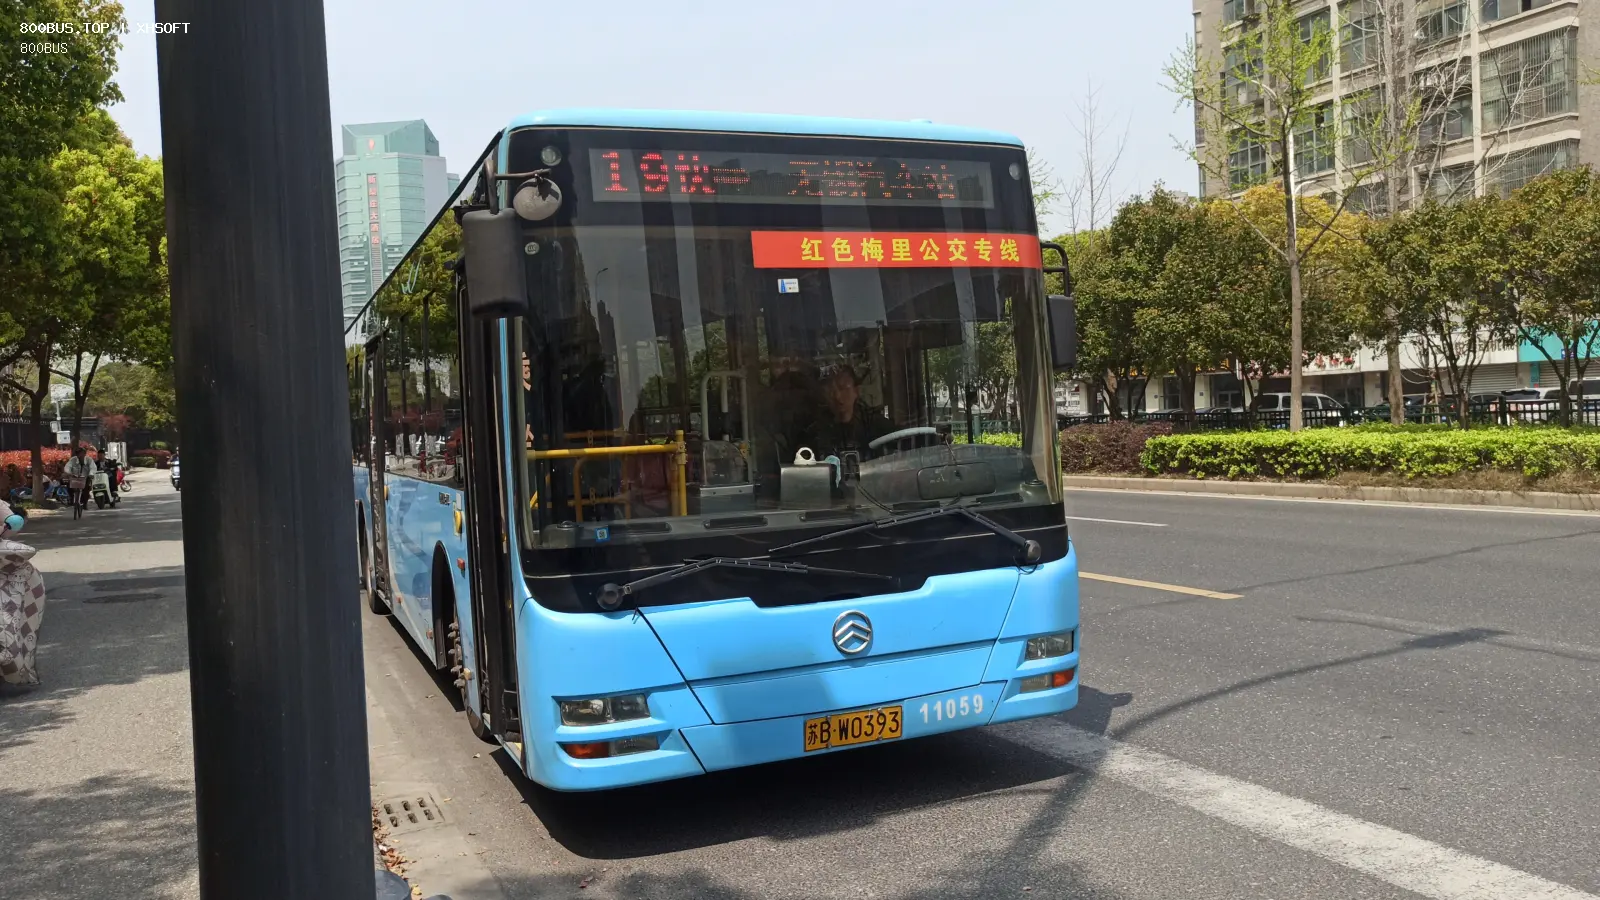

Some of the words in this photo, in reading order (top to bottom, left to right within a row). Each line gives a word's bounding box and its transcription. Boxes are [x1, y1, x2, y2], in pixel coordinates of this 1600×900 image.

[800, 237, 1020, 262] 红色梅里公交专线
[919, 694, 984, 724] 11059
